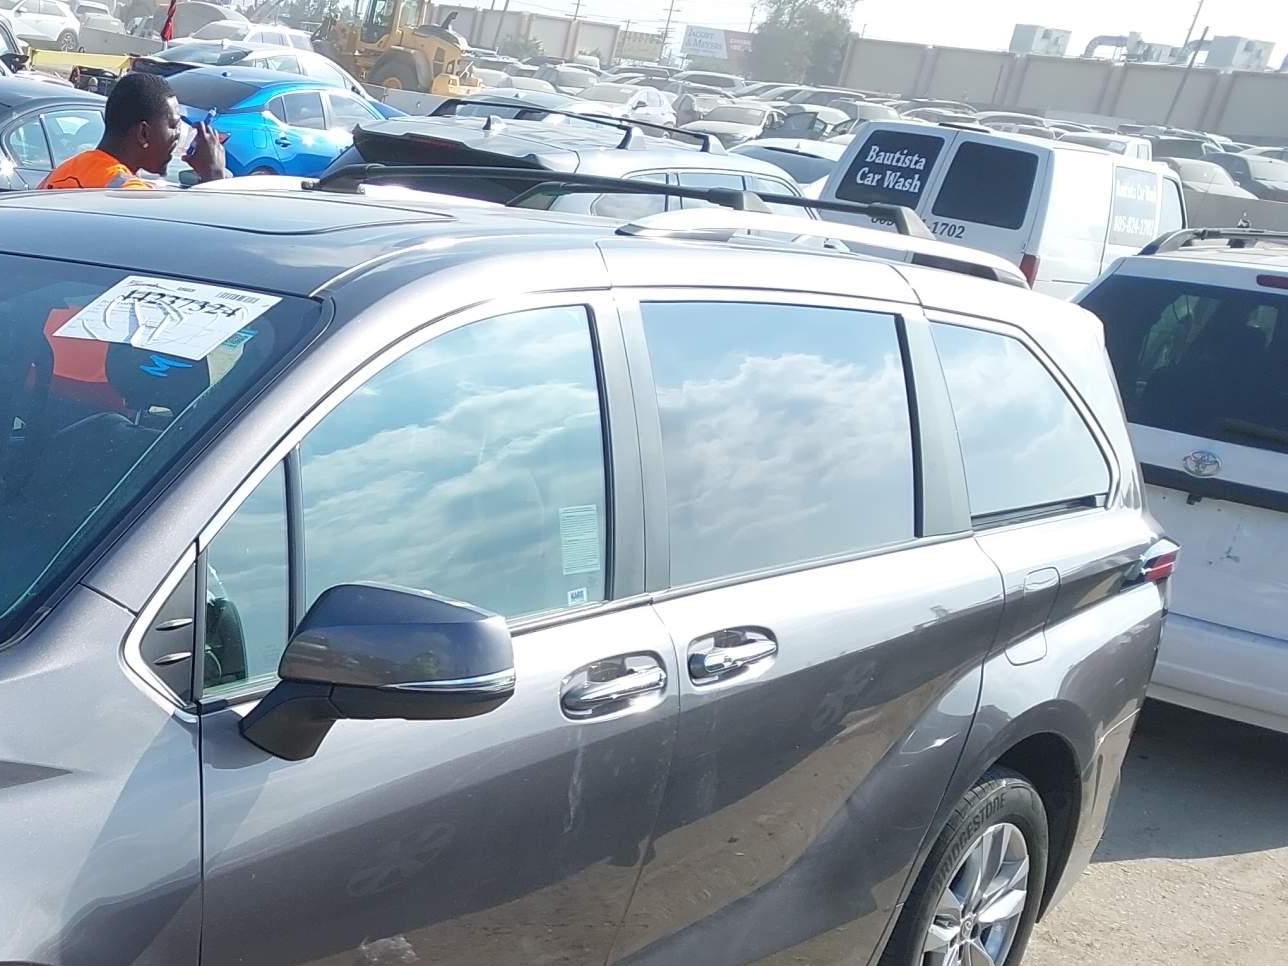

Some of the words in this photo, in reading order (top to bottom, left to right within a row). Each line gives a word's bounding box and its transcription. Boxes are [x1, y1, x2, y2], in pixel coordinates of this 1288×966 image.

[866, 145, 926, 170] Bautista
[856, 167, 882, 186] Car
[883, 170, 921, 193] Wash
